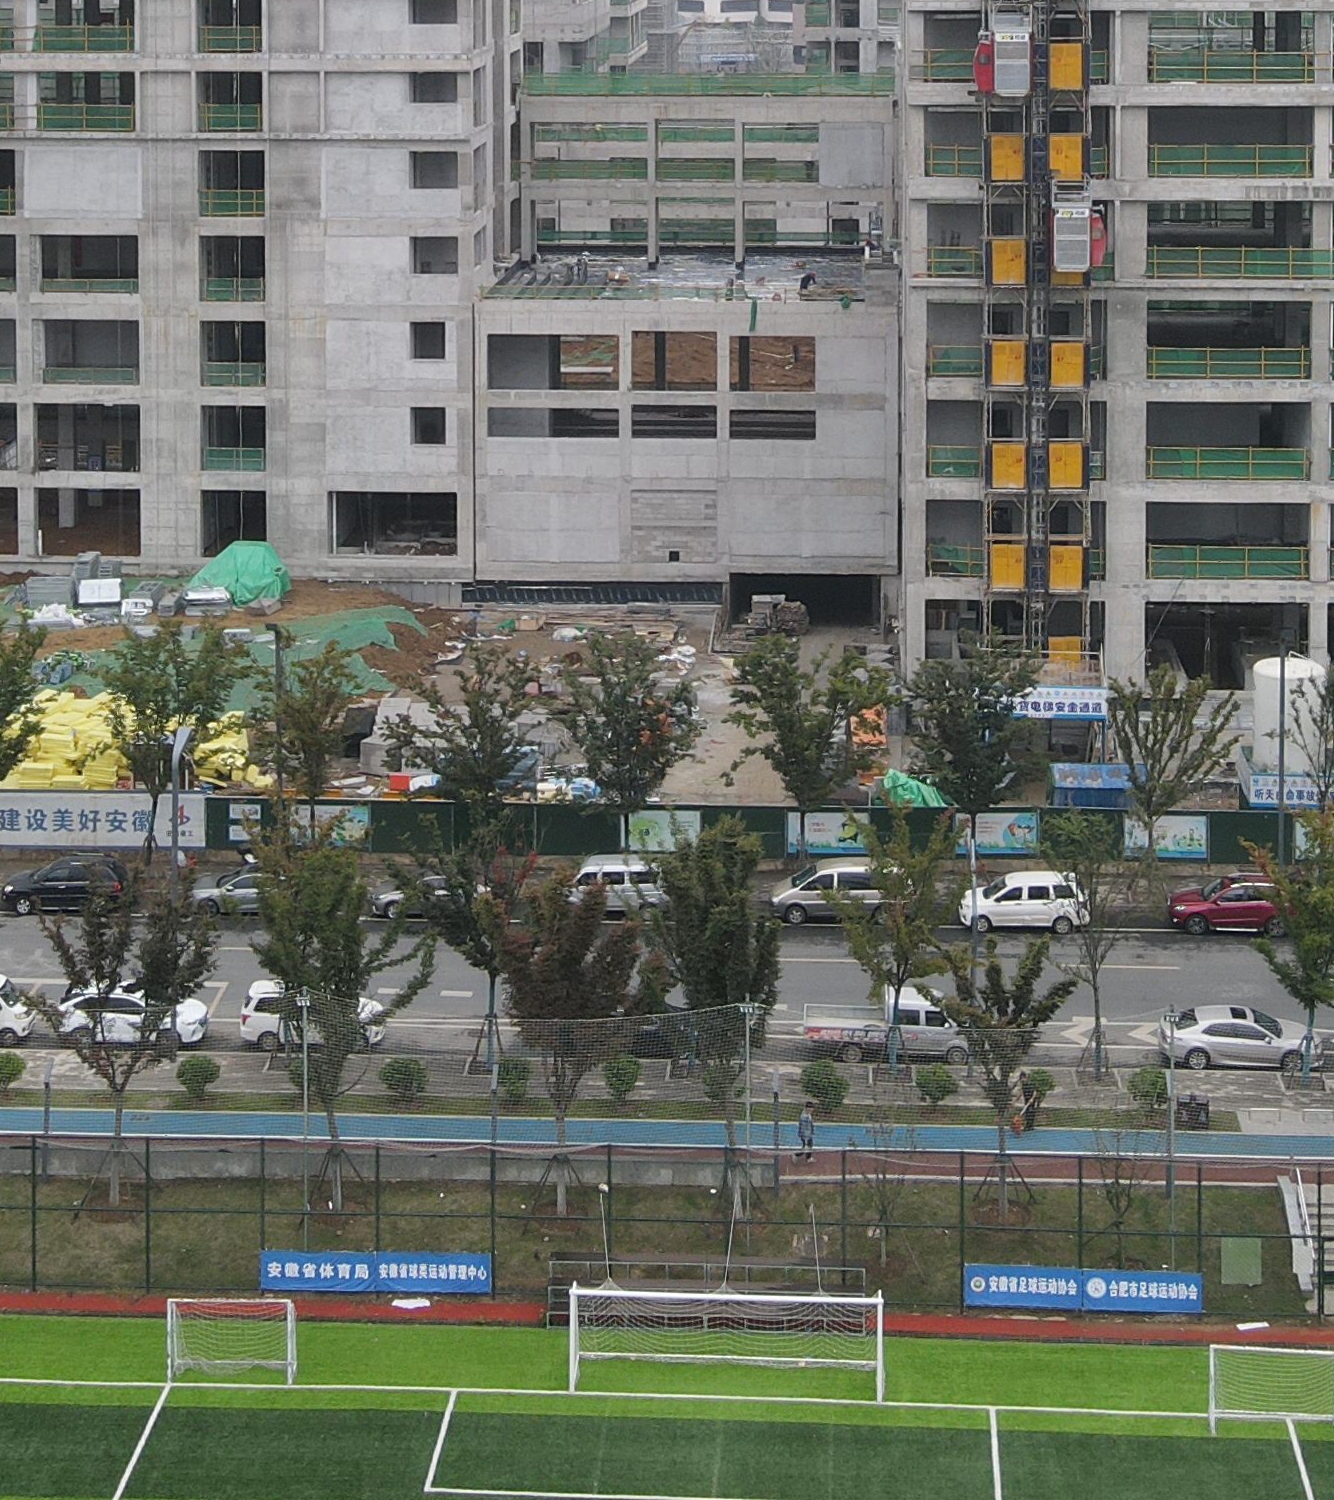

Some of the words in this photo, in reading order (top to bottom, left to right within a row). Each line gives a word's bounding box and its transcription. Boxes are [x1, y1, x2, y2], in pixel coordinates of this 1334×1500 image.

[1013, 701, 1103, 713] 货电梯安全通道
[267, 1262, 369, 1280] 安徽省体育局
[988, 1275, 1078, 1296] 安徽省足球运动协会
[1108, 1279, 1199, 1301] 合肥市足球运动协会
